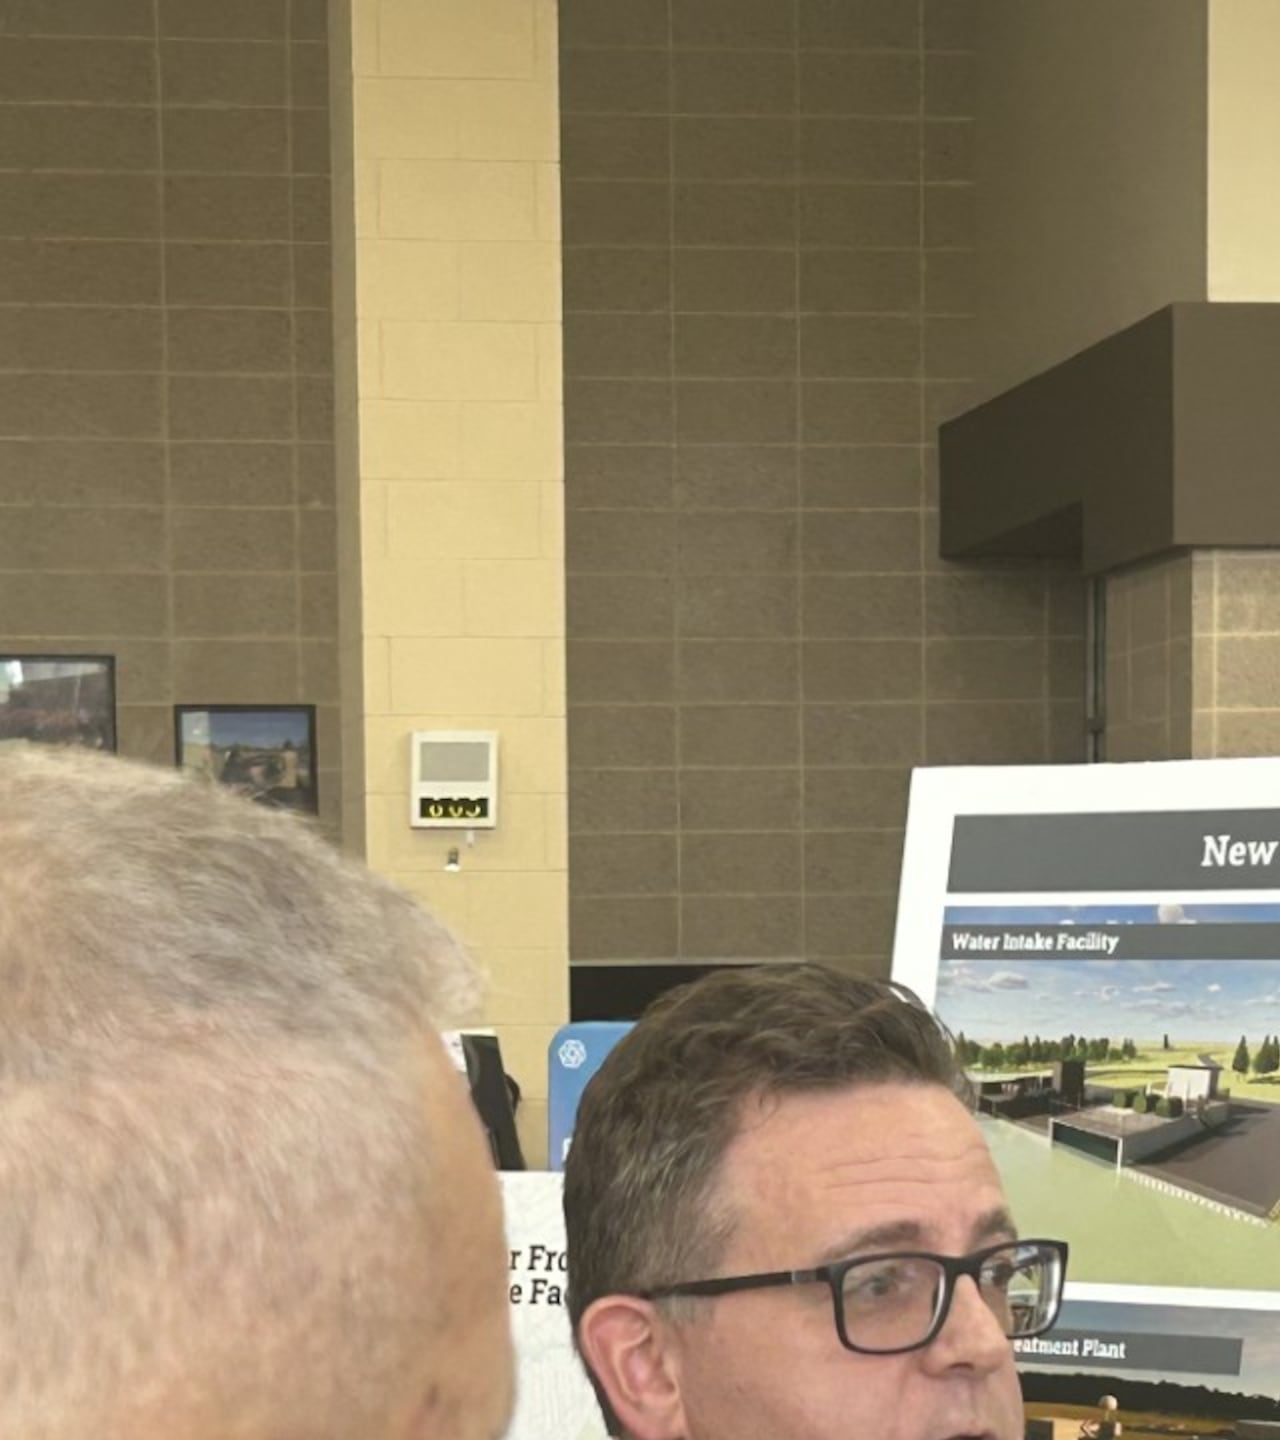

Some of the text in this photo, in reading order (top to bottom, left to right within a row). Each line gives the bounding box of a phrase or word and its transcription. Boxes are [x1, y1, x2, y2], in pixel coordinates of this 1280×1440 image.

[1200, 834, 1278, 868] New
[952, 931, 1120, 955] Water Intake Facility
[1081, 1338, 1126, 1359] Plant
